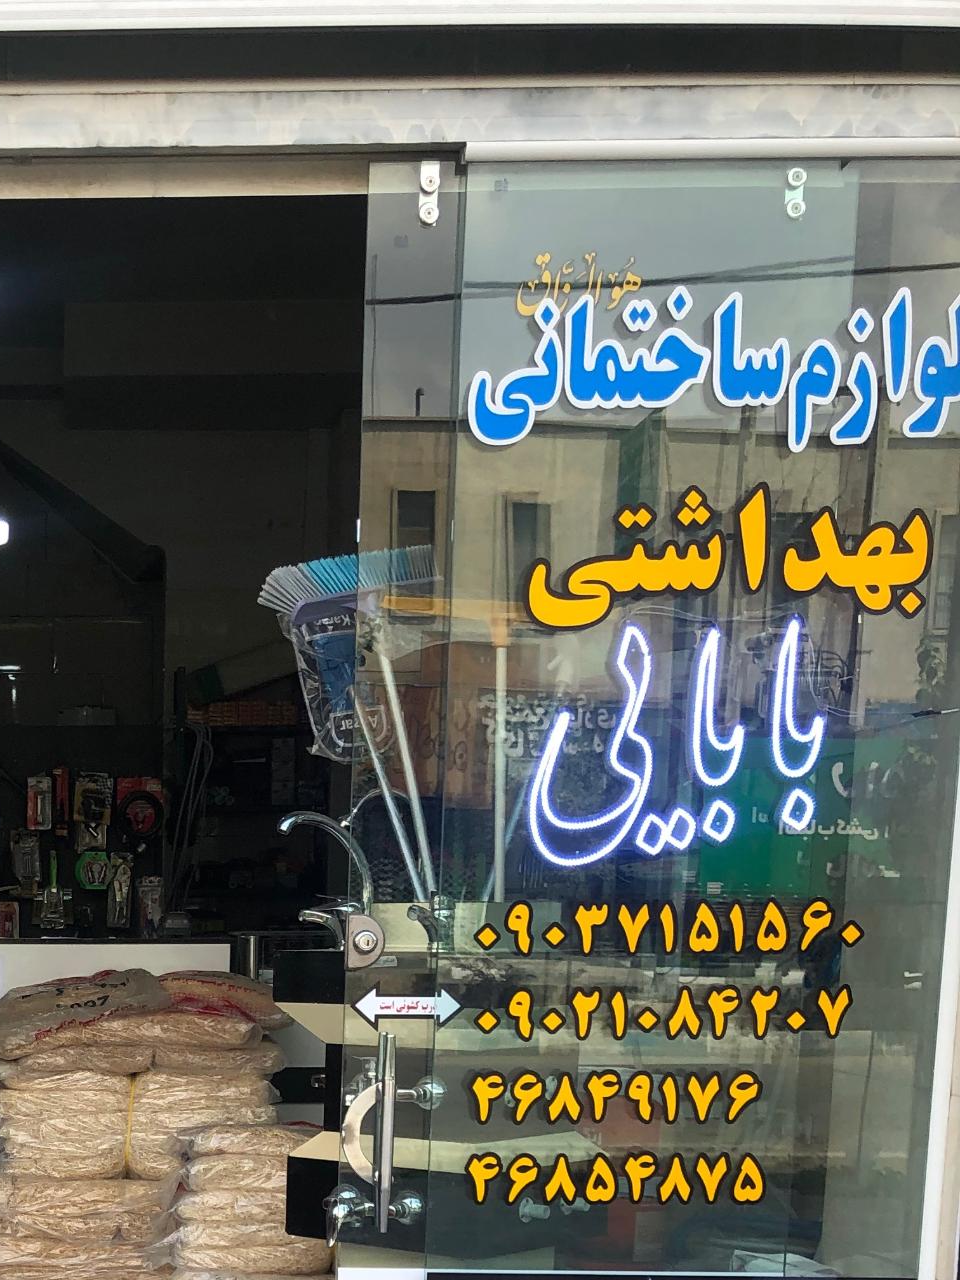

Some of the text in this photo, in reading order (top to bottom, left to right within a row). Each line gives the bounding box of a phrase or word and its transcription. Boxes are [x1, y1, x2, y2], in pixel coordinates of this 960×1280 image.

[467, 285, 790, 446] ساختمانی
[526, 482, 935, 633] بهداشتی
[472, 901, 865, 955] ۰۹۰۳۷۱۵۱۵۶۰
[472, 985, 852, 1041] ۰۹۰۲۱۰۸۴۲۰۷
[472, 1070, 761, 1124] ۴۶۸۴۹۱۷۶
[465, 1152, 765, 1204] ۴۶۸۵۴۸۷۵
